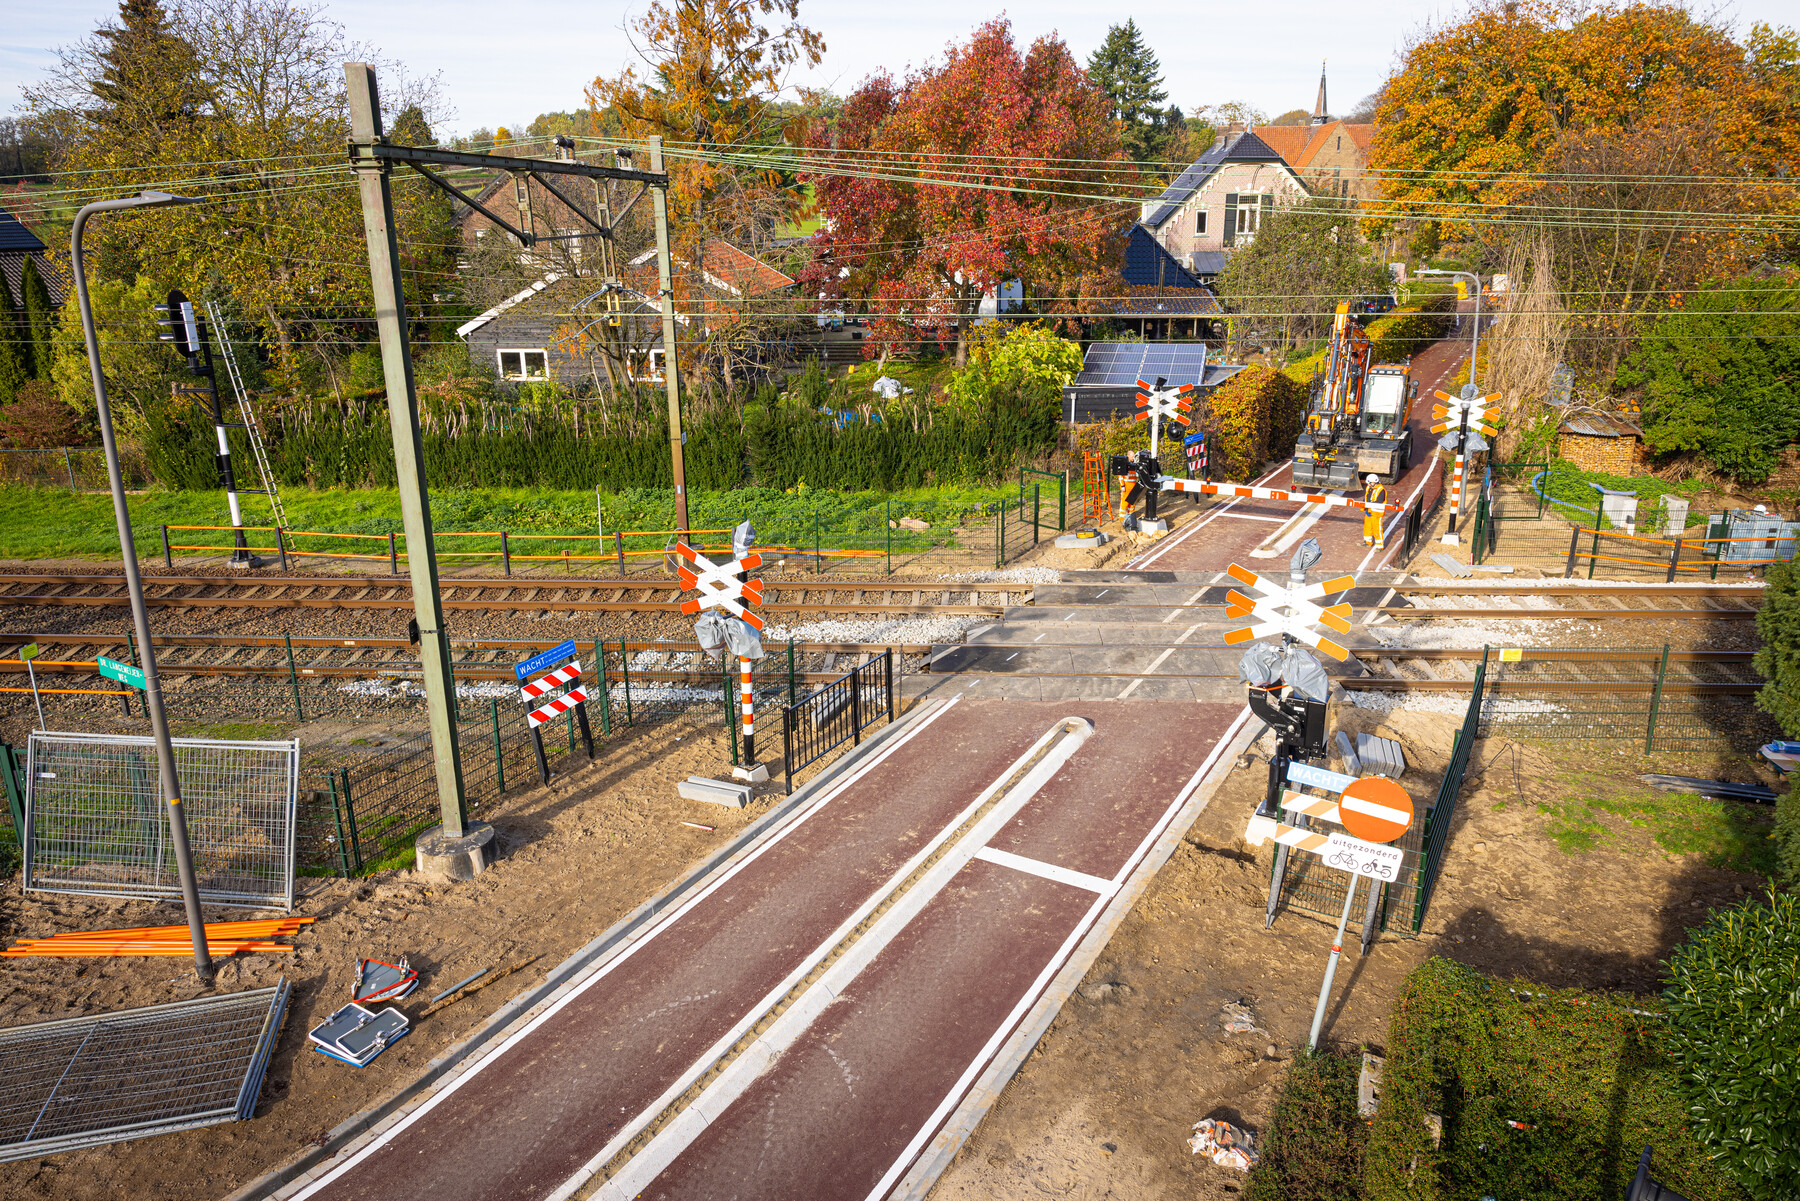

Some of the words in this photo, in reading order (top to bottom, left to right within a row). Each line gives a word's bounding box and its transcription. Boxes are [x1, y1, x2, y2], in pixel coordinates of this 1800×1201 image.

[519, 657, 545, 675] WACHT
[118, 673, 128, 683] WEG
[1292, 766, 1339, 787] WACHT
[1332, 838, 1399, 861] uitgezonderd
